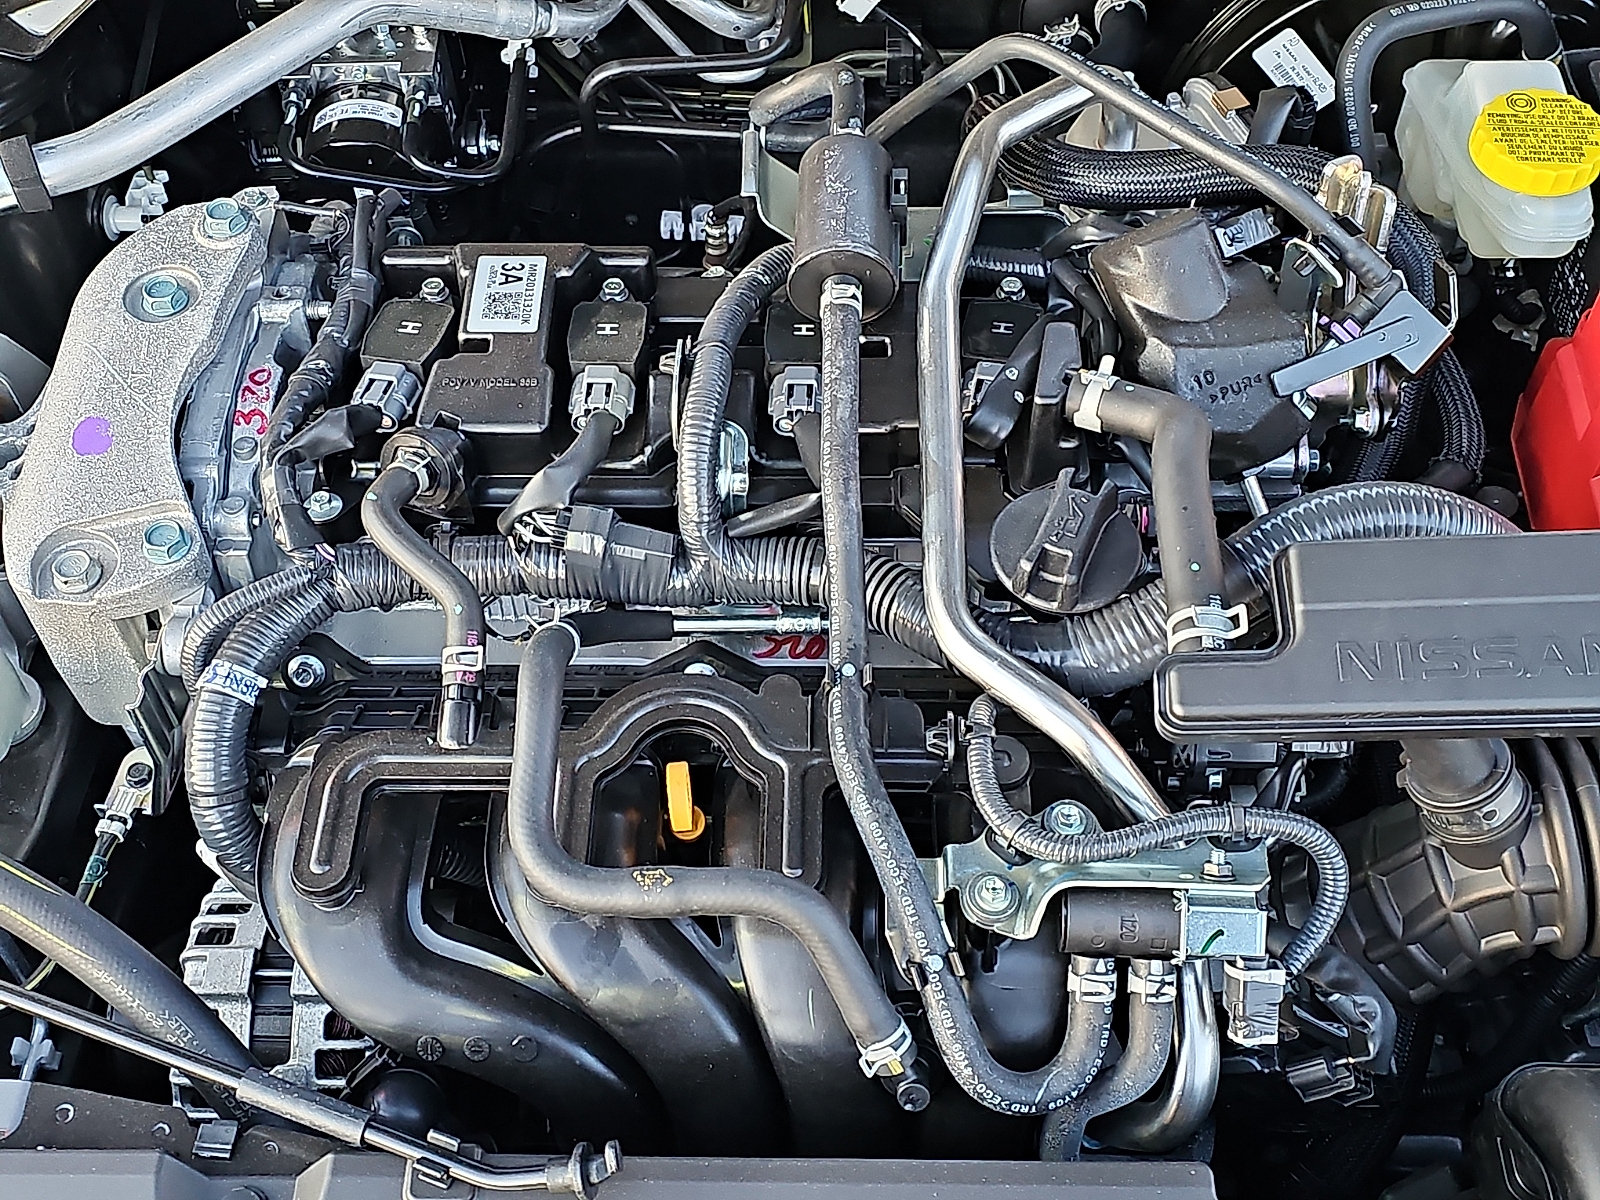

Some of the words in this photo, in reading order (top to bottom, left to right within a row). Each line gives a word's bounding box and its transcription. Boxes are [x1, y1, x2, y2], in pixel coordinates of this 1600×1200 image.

[498, 262, 525, 287] 3A
[520, 263, 538, 326] MR20131320K
[397, 320, 423, 335] H
[596, 322, 620, 336] H
[1193, 370, 1215, 390] 10
[1119, 912, 1140, 944] 120
